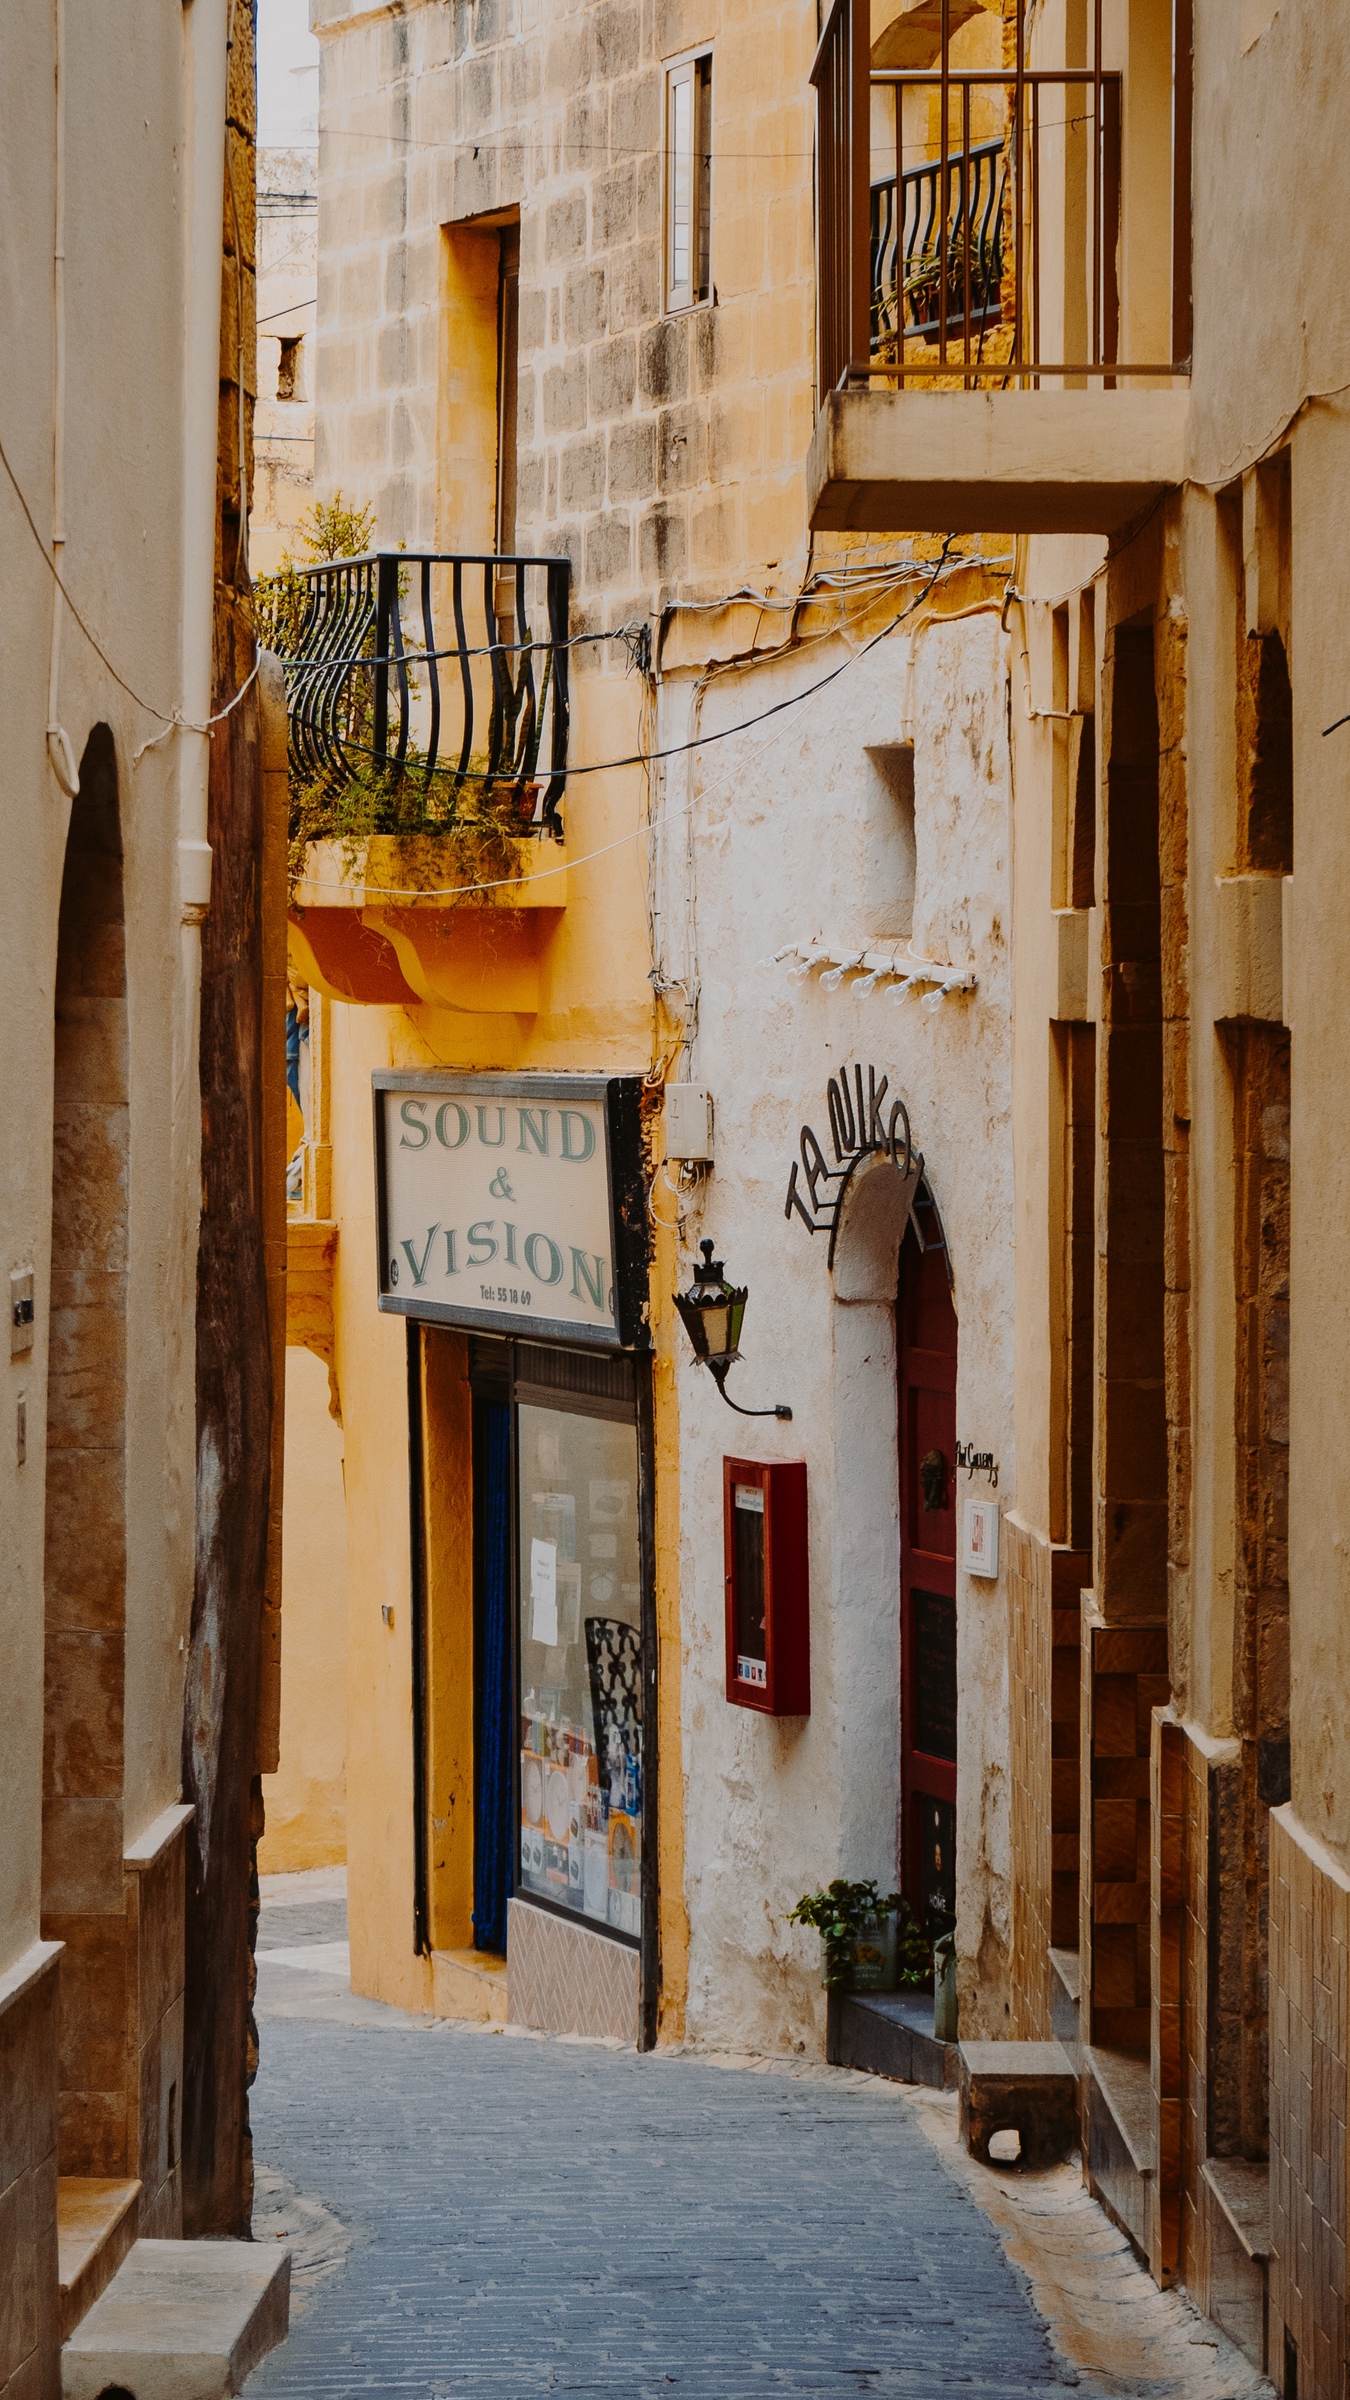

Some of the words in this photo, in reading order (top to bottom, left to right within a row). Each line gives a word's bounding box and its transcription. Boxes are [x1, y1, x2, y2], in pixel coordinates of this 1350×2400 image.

[399, 1099, 596, 1163] SOUND
[488, 1166, 517, 1203] &
[400, 1220, 604, 1312] VISION
[480, 1285, 494, 1301] Tel:
[497, 1287, 507, 1302] 55
[509, 1289, 518, 1304] 18
[521, 1290, 531, 1306] 69
